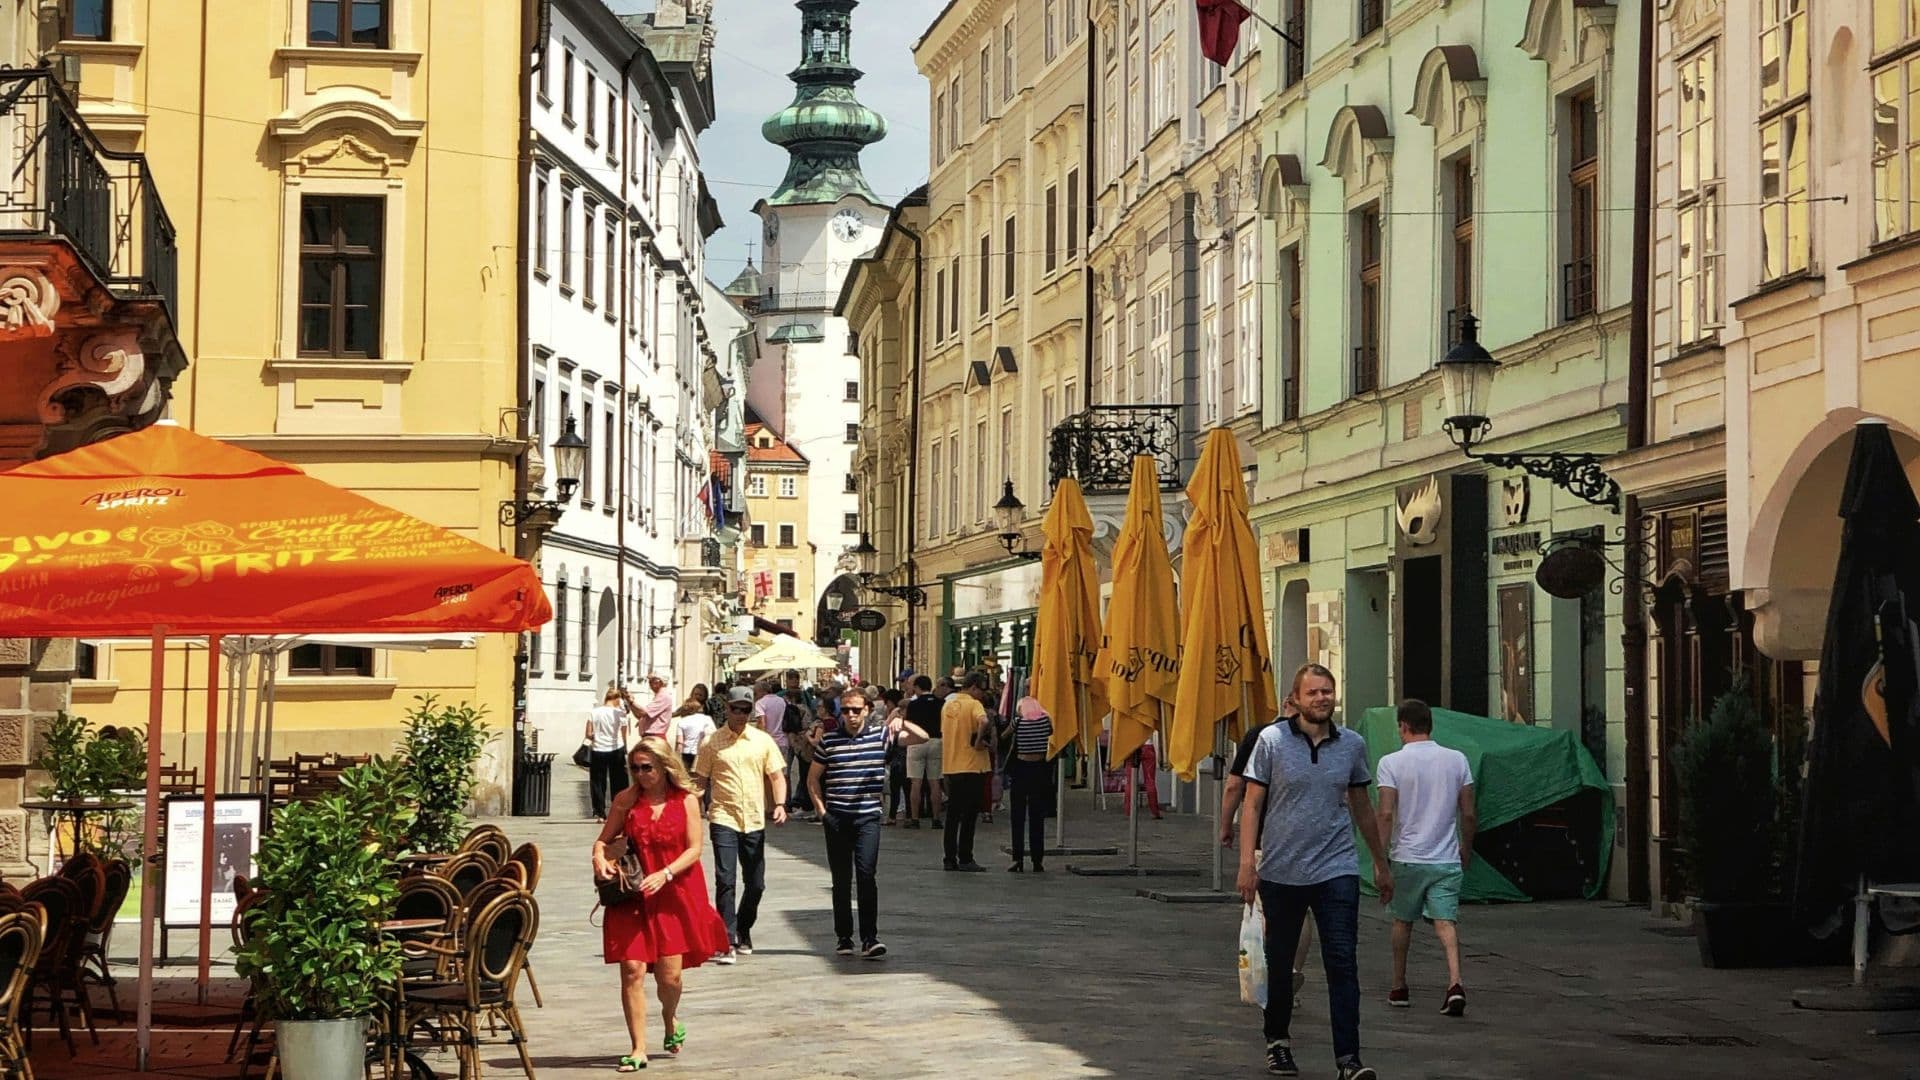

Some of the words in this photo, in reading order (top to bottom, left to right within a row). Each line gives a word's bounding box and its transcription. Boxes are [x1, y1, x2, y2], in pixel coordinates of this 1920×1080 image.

[80, 487, 187, 506] APEROL
[96, 496, 169, 511] SPRITZ
[240, 513, 348, 529] SPONTANEOUS
[365, 549, 428, 559] PADOVA
[170, 548, 358, 587] SPRITZ
[48, 578, 161, 611] Contagious
[434, 583, 474, 598] APEROL
